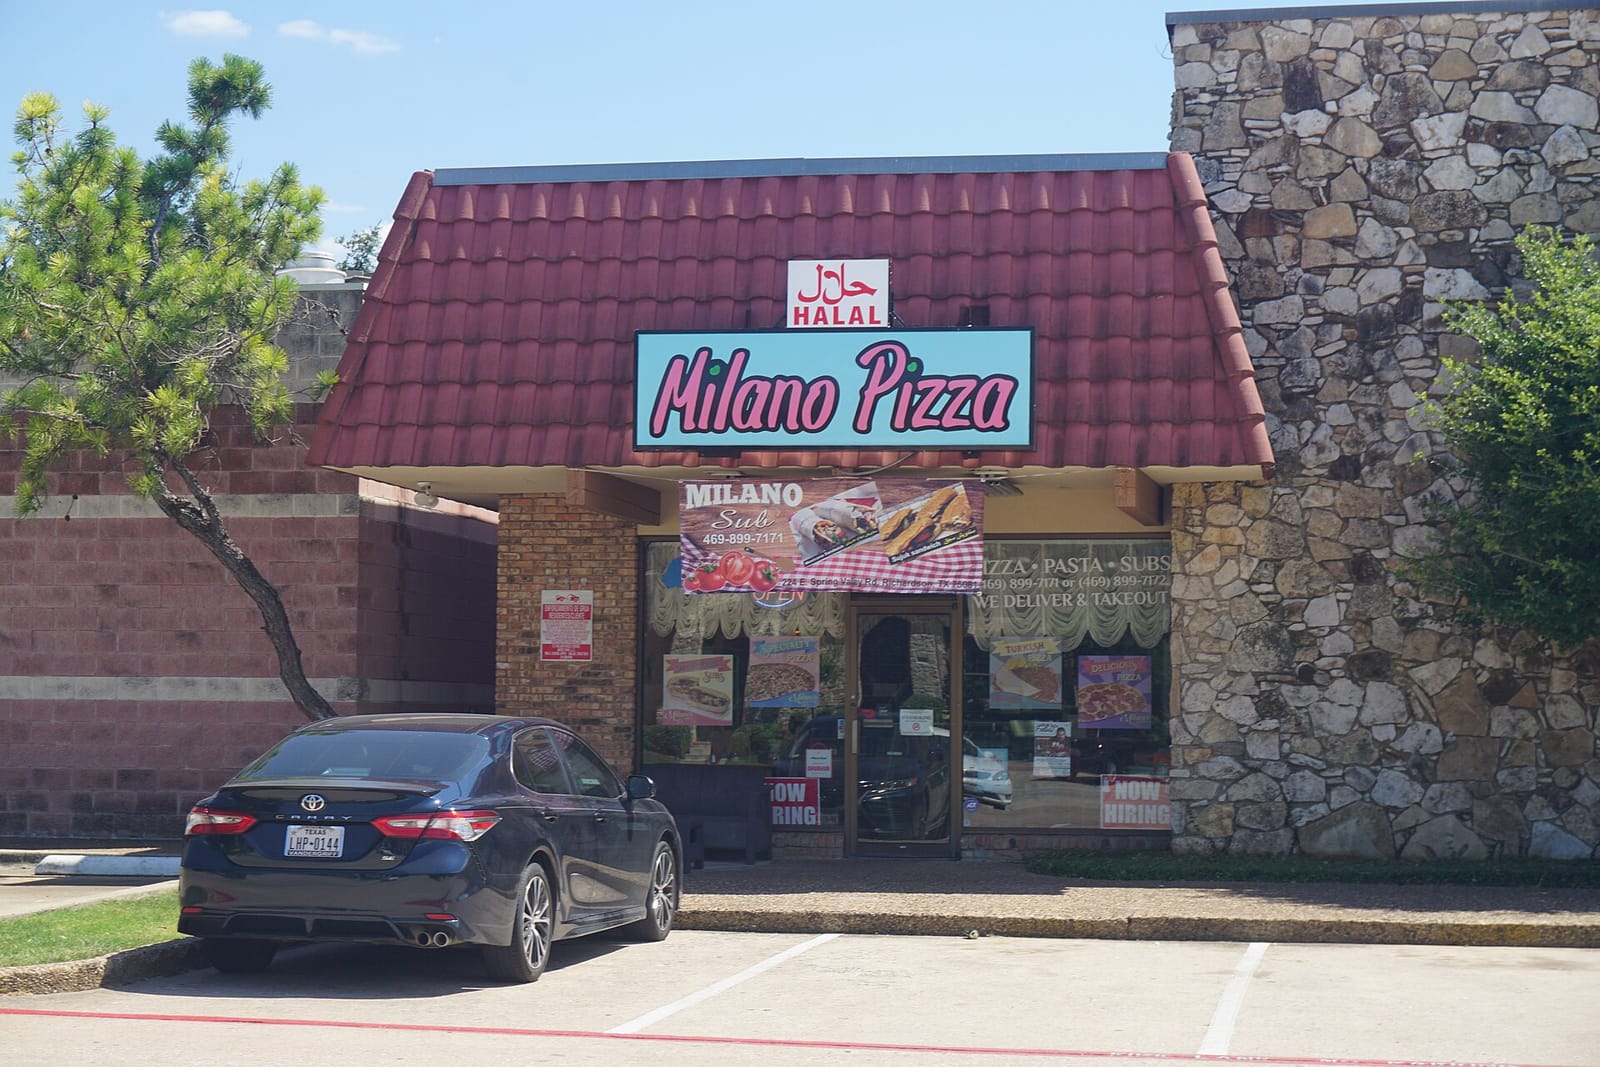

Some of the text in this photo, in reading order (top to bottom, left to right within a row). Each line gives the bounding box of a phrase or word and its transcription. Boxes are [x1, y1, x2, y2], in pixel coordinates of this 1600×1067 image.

[798, 262, 877, 305] حلال
[793, 306, 881, 325] HALAL
[650, 340, 1019, 437] Milano Pizza
[685, 482, 803, 510] MILANO
[711, 509, 775, 530] Sub
[703, 533, 783, 545] 469-899-7171
[983, 555, 1171, 574] IZZA PASTA SUBS
[782, 578, 797, 587] 224
[810, 577, 838, 588] Spring
[938, 579, 949, 588] TX
[1009, 577, 1058, 589] 899-7171
[1062, 580, 1076, 588] or
[1079, 576, 1111, 589] (469)
[973, 590, 1169, 608] WE DELIVER & TAKEOUT
[1115, 781, 1160, 800] NOW
[1104, 803, 1170, 824] HIRING
[304, 828, 327, 836] TEXAS
